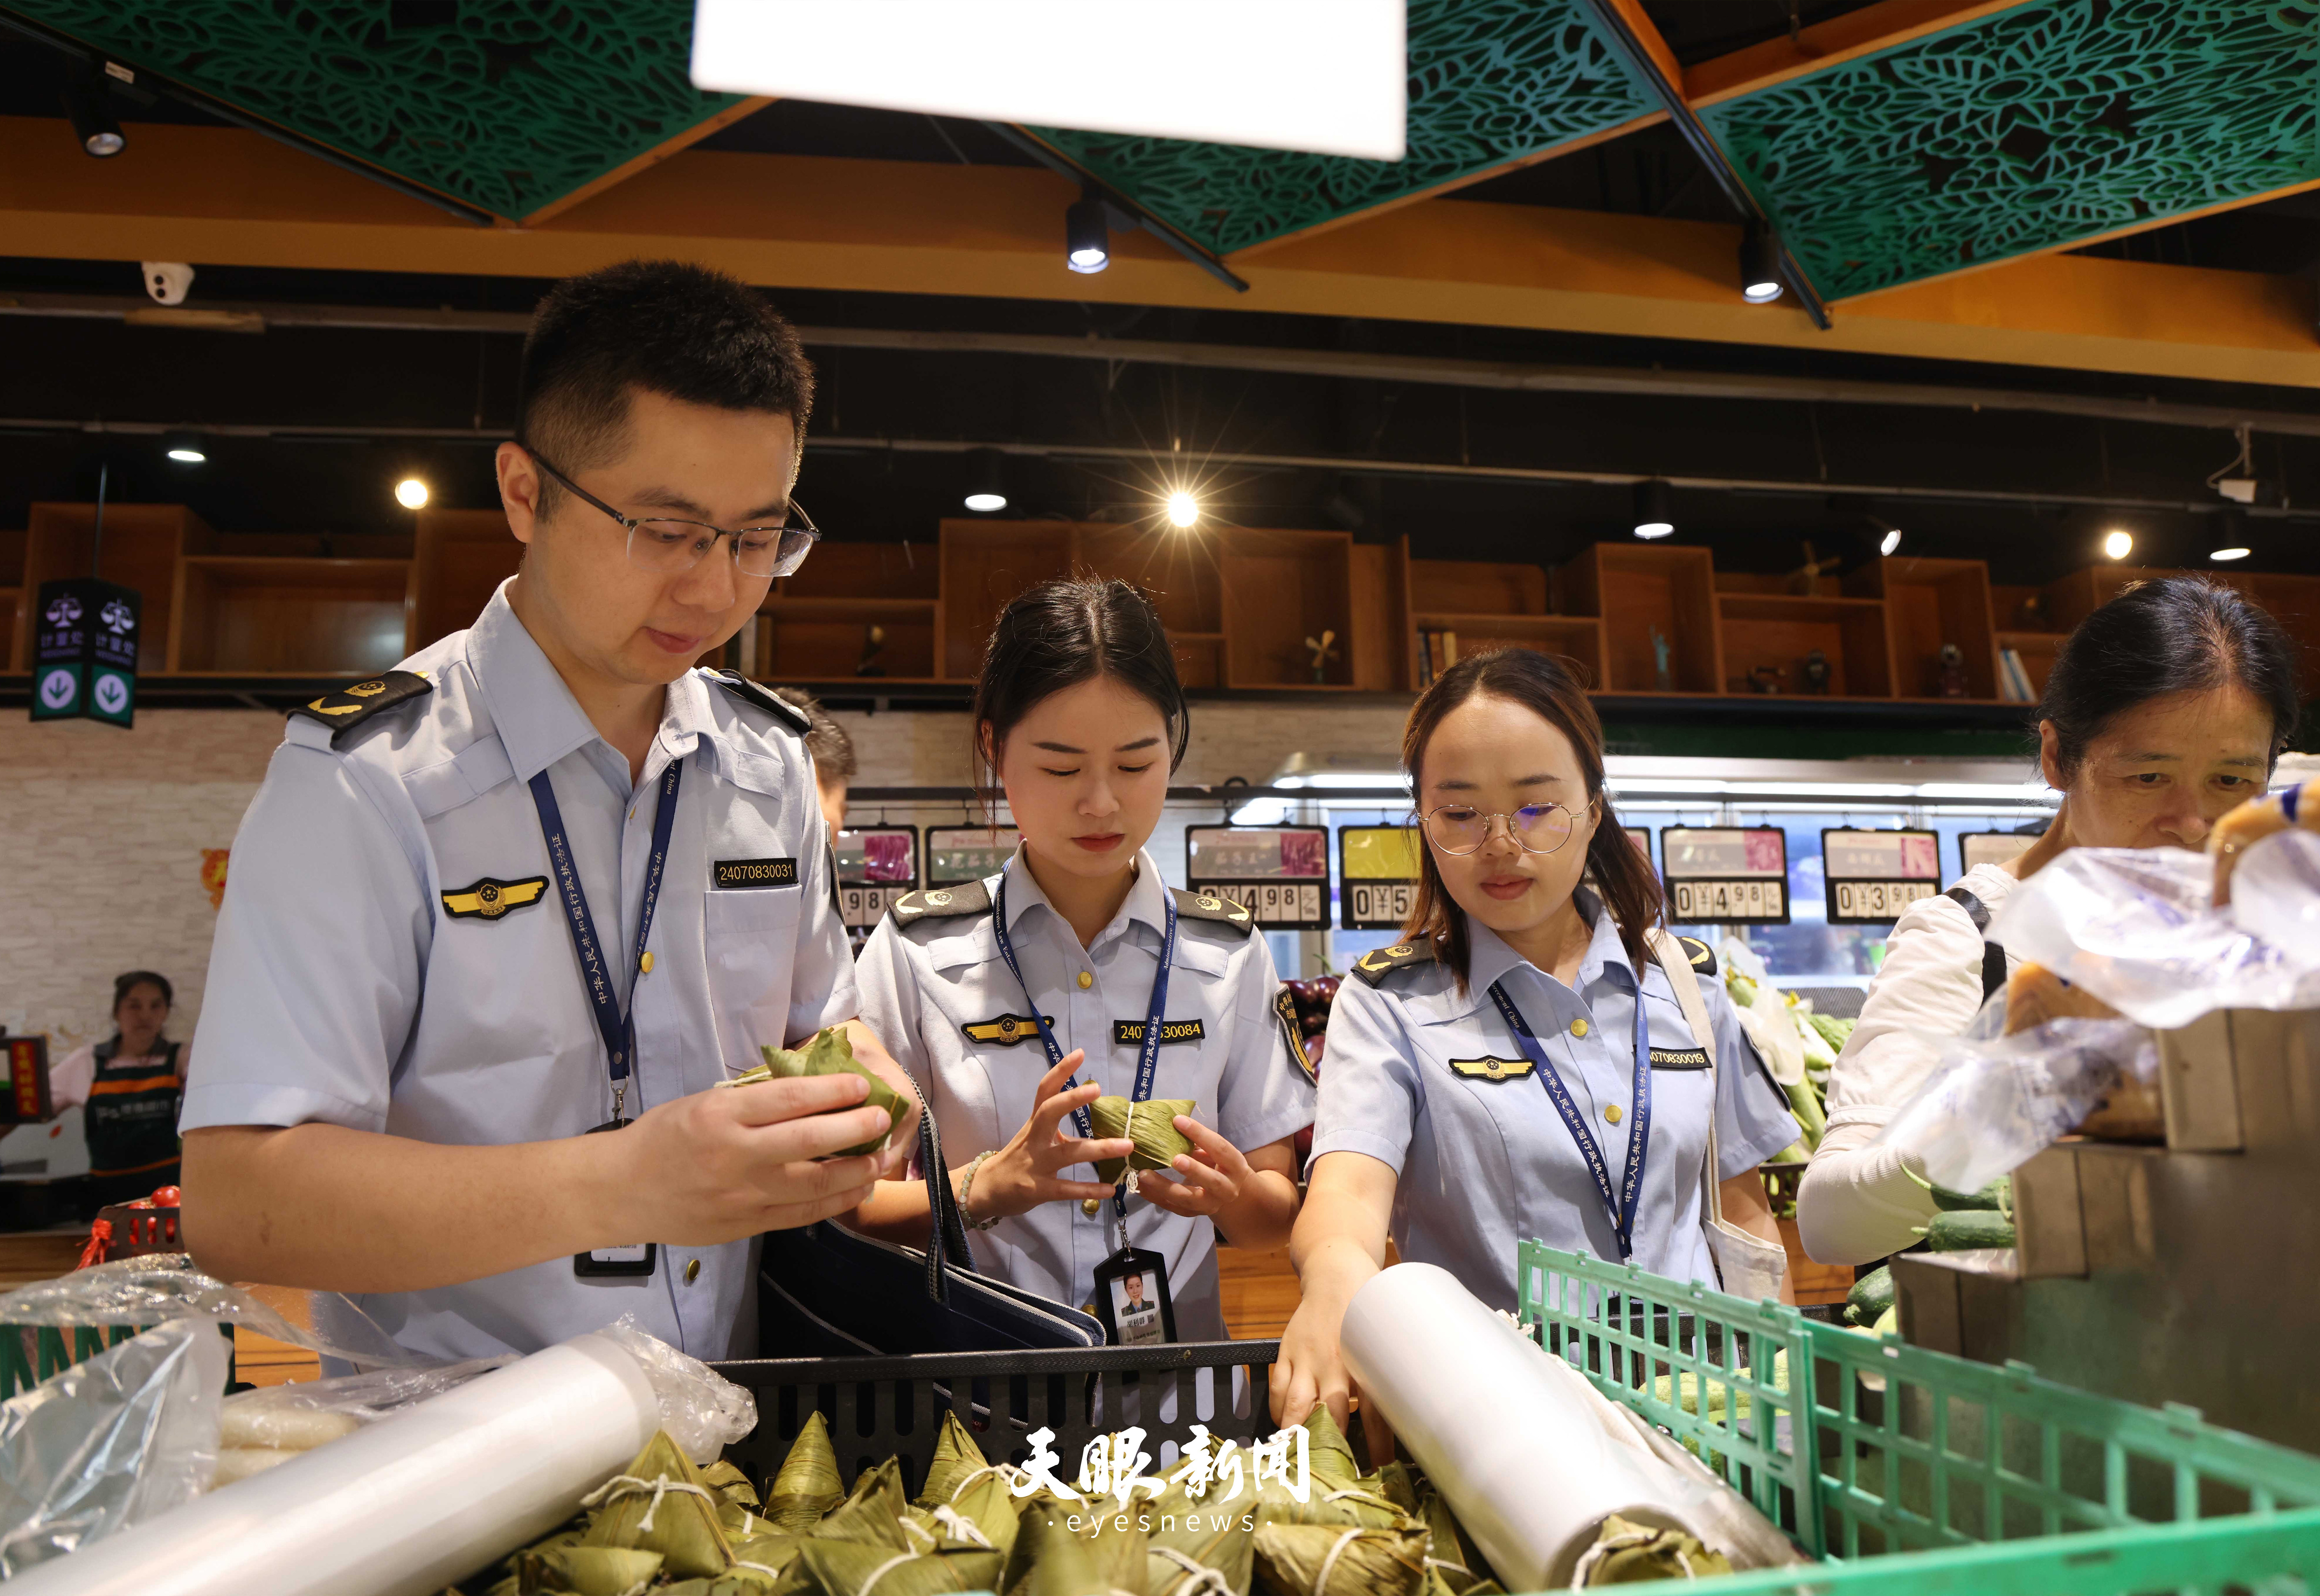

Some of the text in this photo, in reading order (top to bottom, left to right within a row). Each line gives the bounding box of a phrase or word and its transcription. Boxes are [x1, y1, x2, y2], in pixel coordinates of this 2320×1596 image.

[667, 773, 675, 795] China
[719, 863, 794, 881] 24070830031
[552, 833, 608, 1004] 中华人民共和国行政执法证
[1003, 946, 1023, 984] Enforcement
[1163, 928, 1172, 971] Administrative
[1121, 1023, 1200, 1039] 24030084
[1508, 1011, 1520, 1028] China
[1138, 1015, 1159, 1100] 共和国行政执法证
[1650, 1052, 1705, 1064] 070830019
[1543, 1068, 1610, 1198] 中华人民共和国行政执法证
[1625, 1067, 1647, 1202] 中华人民共和国行政执法证
